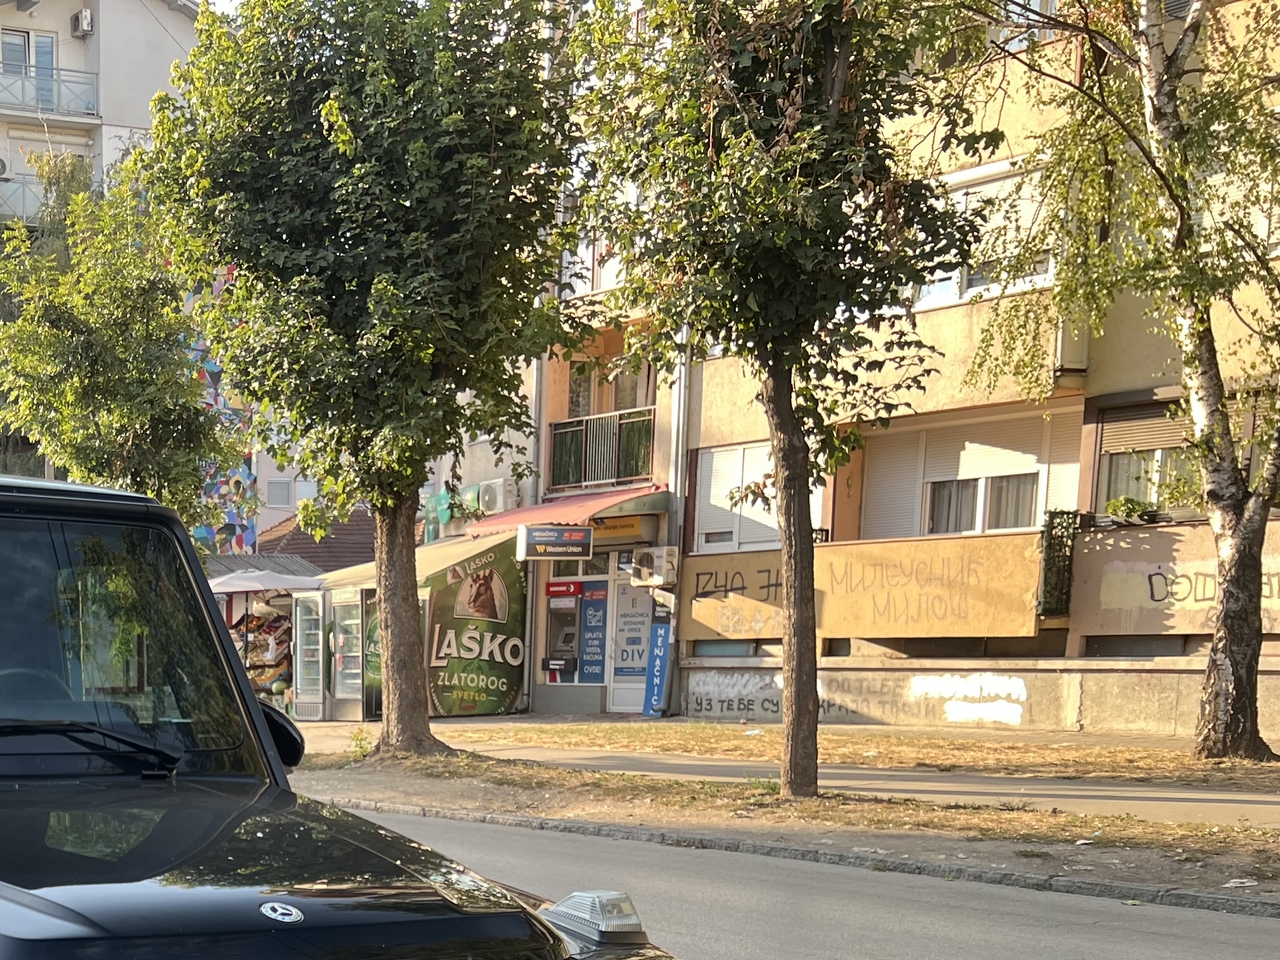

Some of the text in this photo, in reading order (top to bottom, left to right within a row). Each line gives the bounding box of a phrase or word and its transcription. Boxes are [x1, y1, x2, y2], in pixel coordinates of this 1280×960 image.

[546, 545, 582, 553] Western Union
[464, 553, 495, 574] LAŠKO
[871, 590, 968, 625] МИЛОШ
[430, 624, 524, 667] LAŠKO
[621, 649, 645, 662] DIV
[437, 672, 508, 691] ZLATOROG
[452, 690, 487, 701] SVETLO
[717, 698, 756, 713] ТЕБЕ
[760, 698, 780, 714] СУ
